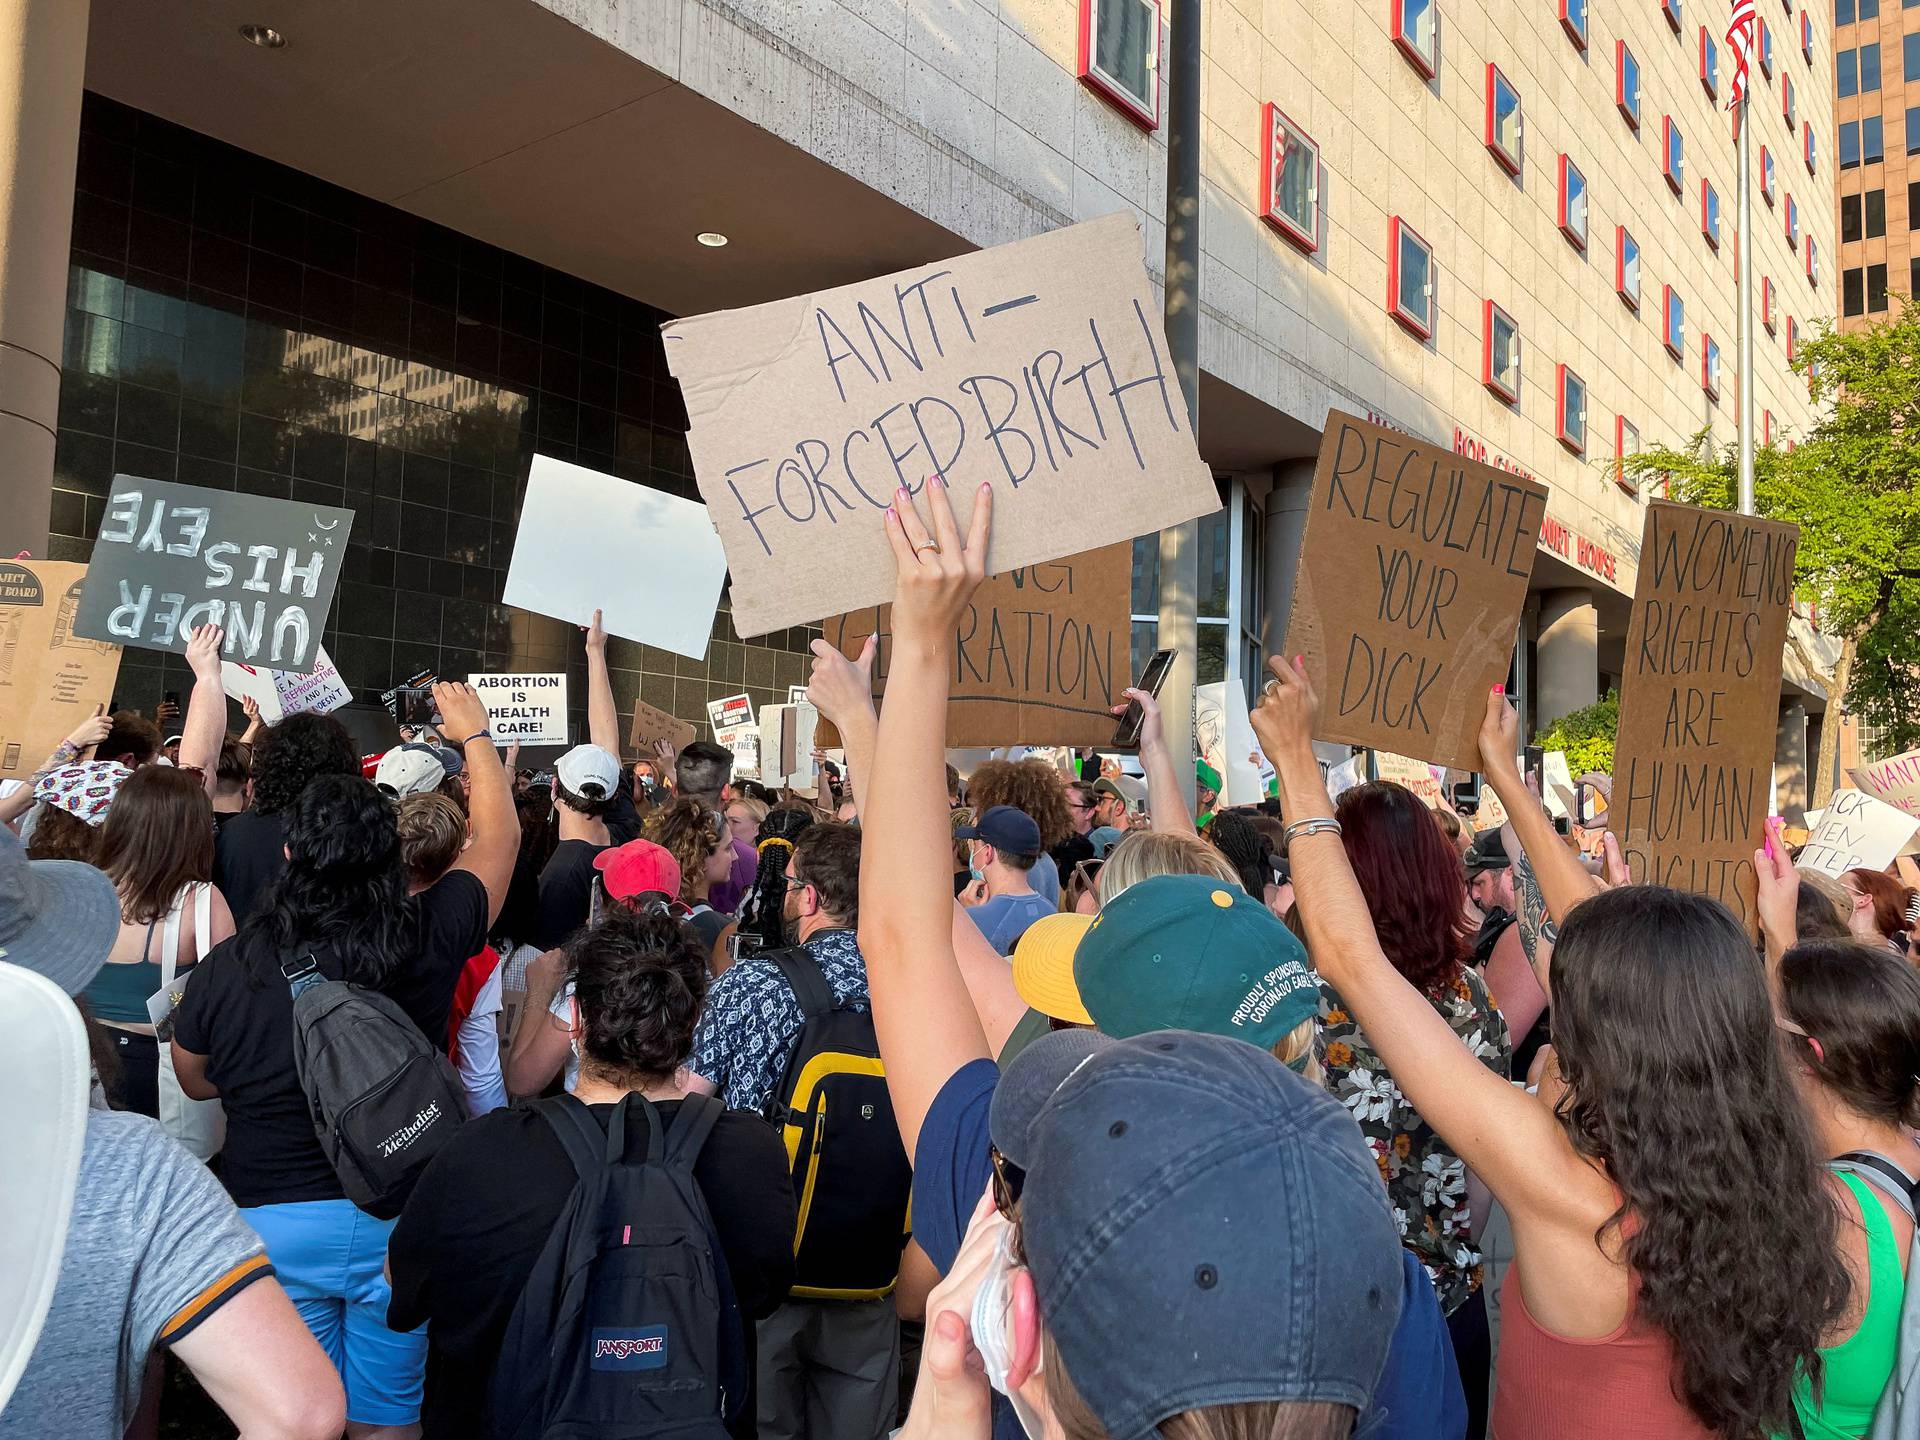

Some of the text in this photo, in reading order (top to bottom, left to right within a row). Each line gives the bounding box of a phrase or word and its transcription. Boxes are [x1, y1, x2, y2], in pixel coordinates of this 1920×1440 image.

[725, 298, 1179, 556] FORCED BIRTH
[101, 489, 210, 558] EYE
[1327, 423, 1548, 578] REGULATE
[204, 540, 324, 598] HIS
[1577, 531, 1617, 584] HOUSE
[1653, 509, 1796, 607] WOMEN'S
[5, 587, 38, 598] BOARD
[1376, 544, 1459, 640] YOUR
[107, 579, 311, 666] UNDER
[1639, 600, 1761, 678] RIGHTS
[284, 667, 336, 701] REPRODUCTIVE
[295, 661, 325, 681] VIUS
[304, 690, 320, 704] AND
[478, 677, 559, 688] ABORTION
[512, 692, 527, 702] IS
[1339, 633, 1443, 735] DICK
[488, 707, 550, 718] HEALTH
[496, 722, 543, 733] CARE!
[1662, 687, 1727, 748] ARE
[1624, 757, 1754, 844] HUMAN
[1231, 981, 1266, 1027] PROUDLY
[1250, 980, 1292, 1024] CORONADO
[377, 1129, 403, 1149] HOUSTON
[383, 1102, 439, 1158] Methodist
[595, 1336, 663, 1359] JANSPORT
